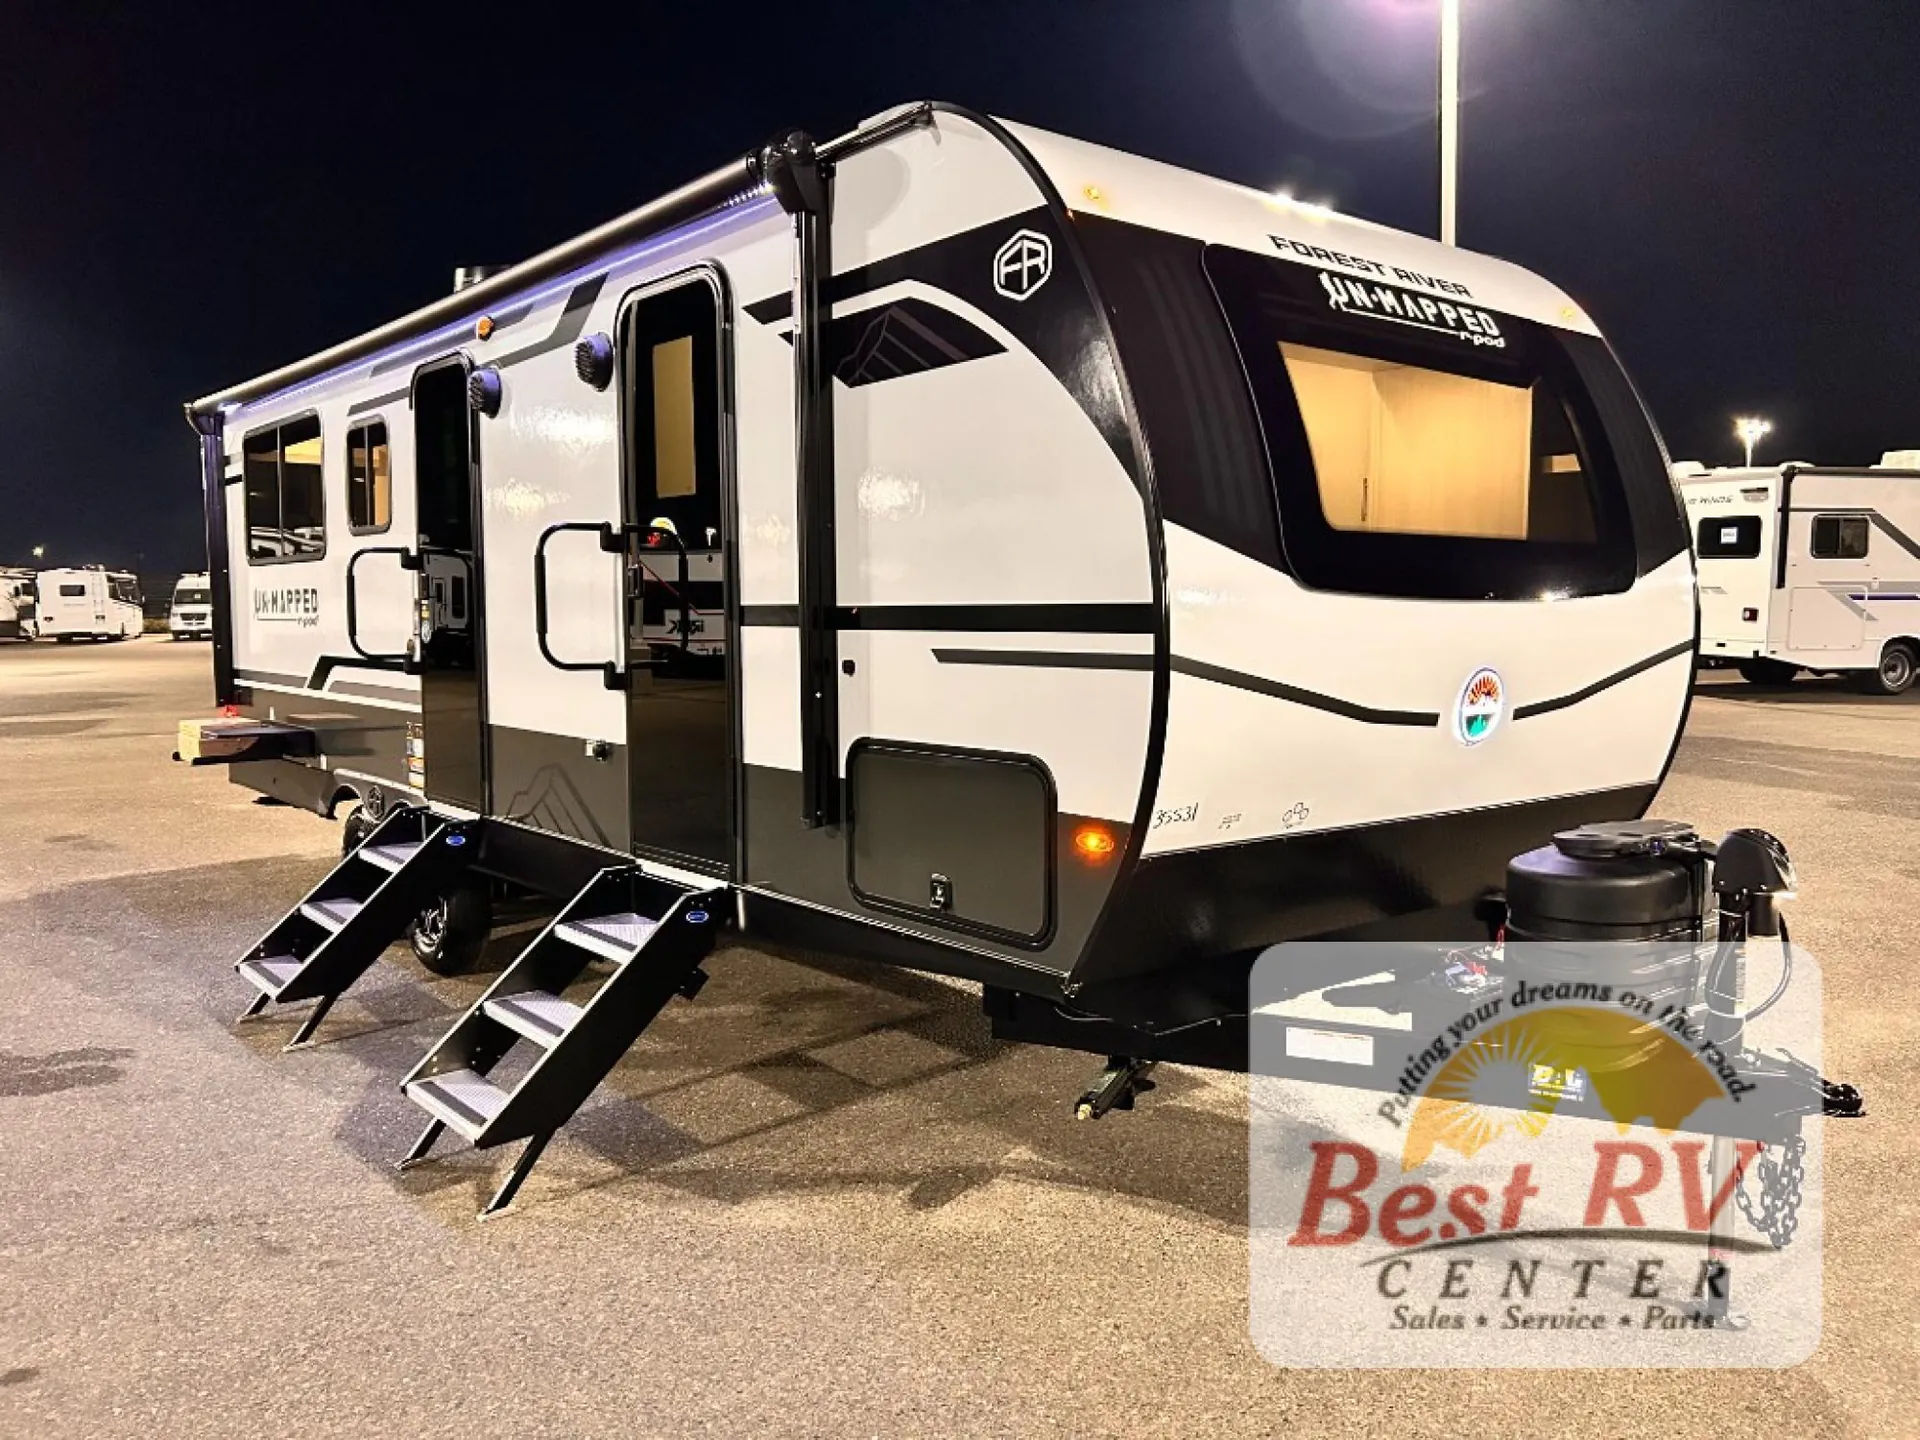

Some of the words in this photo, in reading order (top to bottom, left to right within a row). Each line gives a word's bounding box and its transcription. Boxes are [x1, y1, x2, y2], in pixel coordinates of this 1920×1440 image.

[1267, 234, 1386, 276] FOREST
[1389, 265, 1475, 299] RIVER
[1152, 802, 1199, 830] 35531
